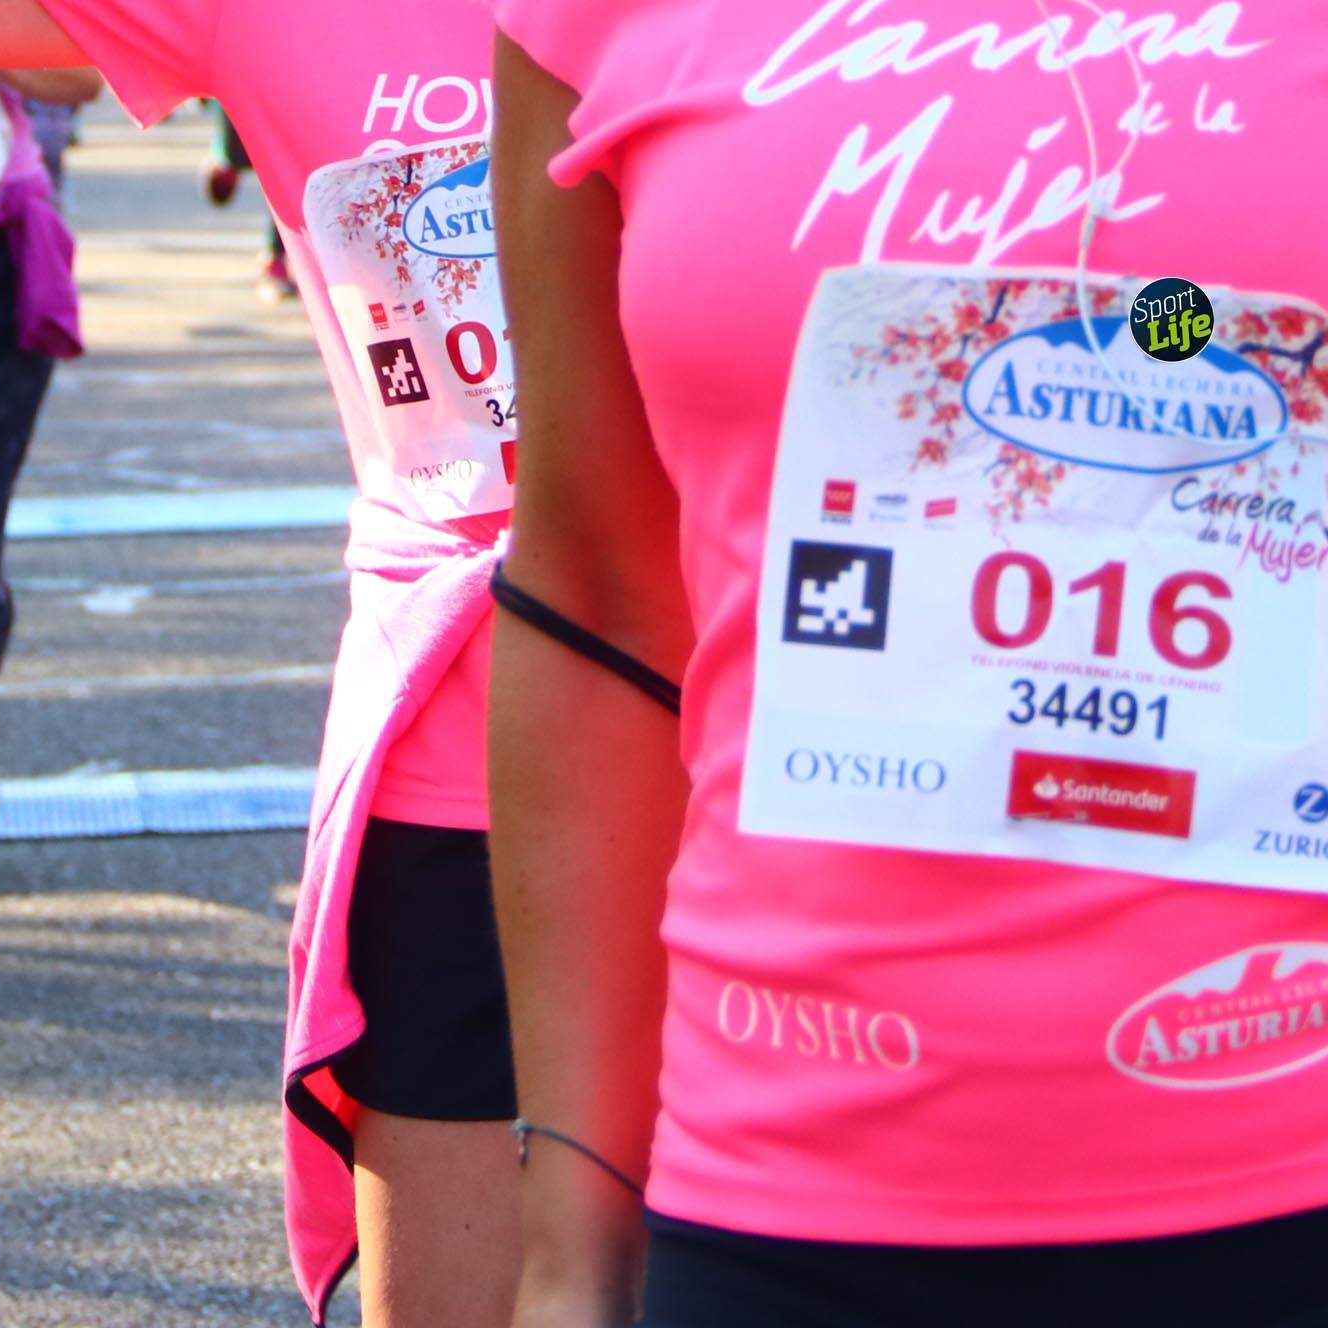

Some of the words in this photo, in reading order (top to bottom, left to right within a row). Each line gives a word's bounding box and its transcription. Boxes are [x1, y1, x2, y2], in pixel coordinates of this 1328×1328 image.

[1118, 82, 1174, 137] de
[1193, 83, 1248, 135] la
[789, 94, 1166, 267] Mujer
[983, 360, 1258, 439] ASTURIANA
[1171, 476, 1297, 523] Carrera
[970, 549, 1234, 671] 016
[1007, 677, 1169, 741] 34491
[785, 747, 948, 794] OYSHO
[1062, 778, 1170, 813] Santander
[717, 979, 919, 1072] OYSHO
